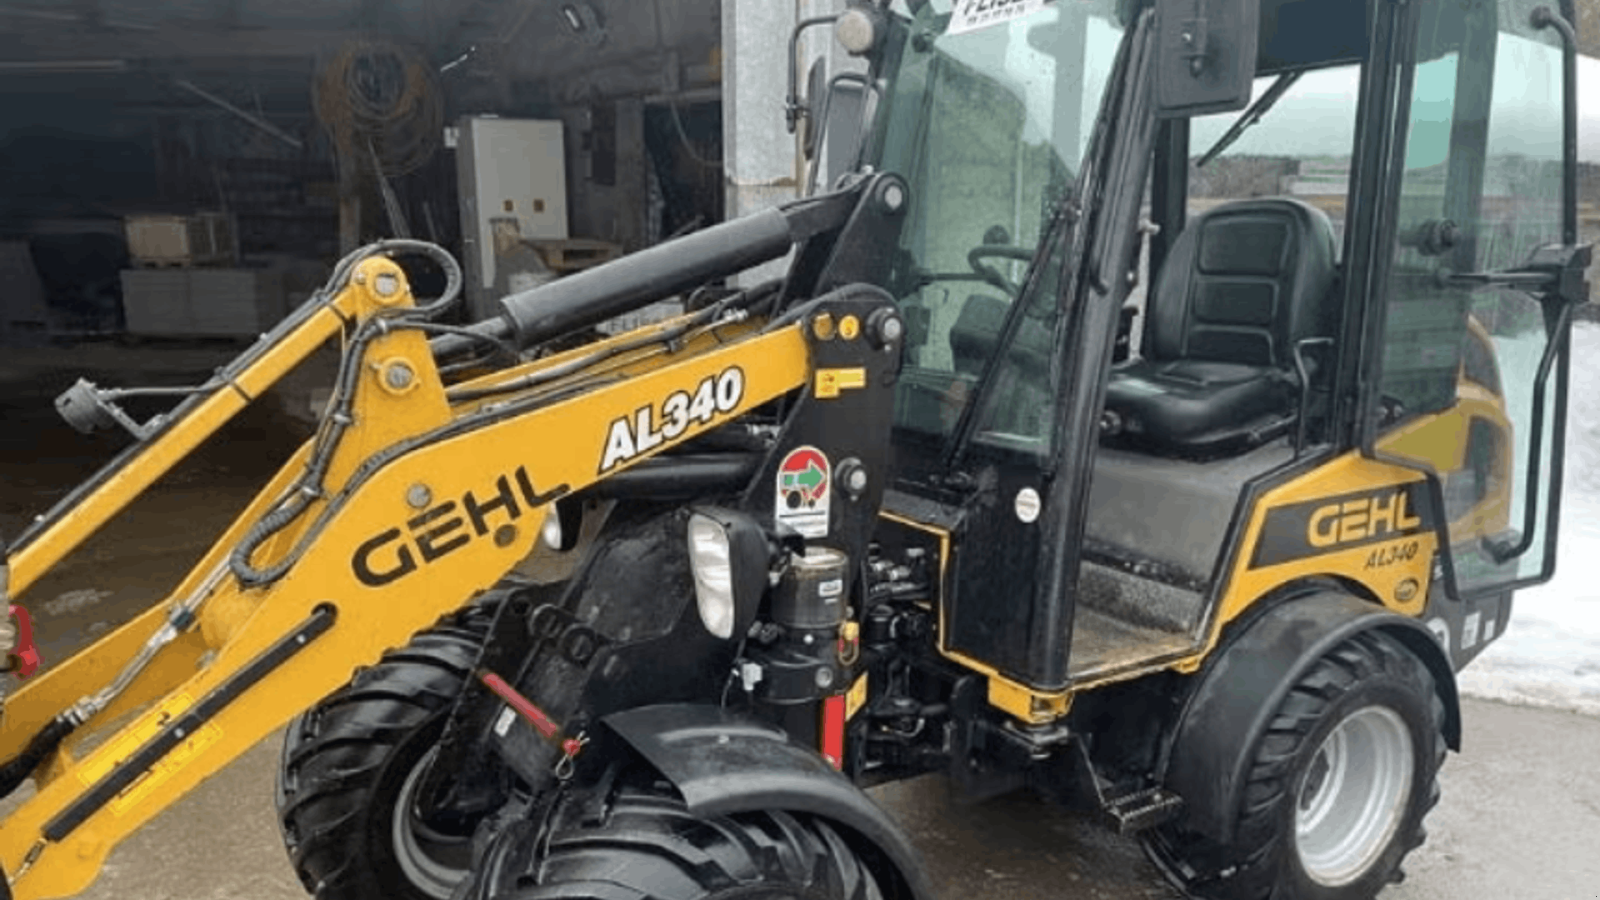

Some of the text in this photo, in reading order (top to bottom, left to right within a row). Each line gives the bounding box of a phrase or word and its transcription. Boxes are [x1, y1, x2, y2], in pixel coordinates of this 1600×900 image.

[600, 367, 744, 474] AL340
[351, 466, 571, 588] GEHL
[1309, 492, 1421, 547] GEHL
[1365, 542, 1418, 568] AL340
